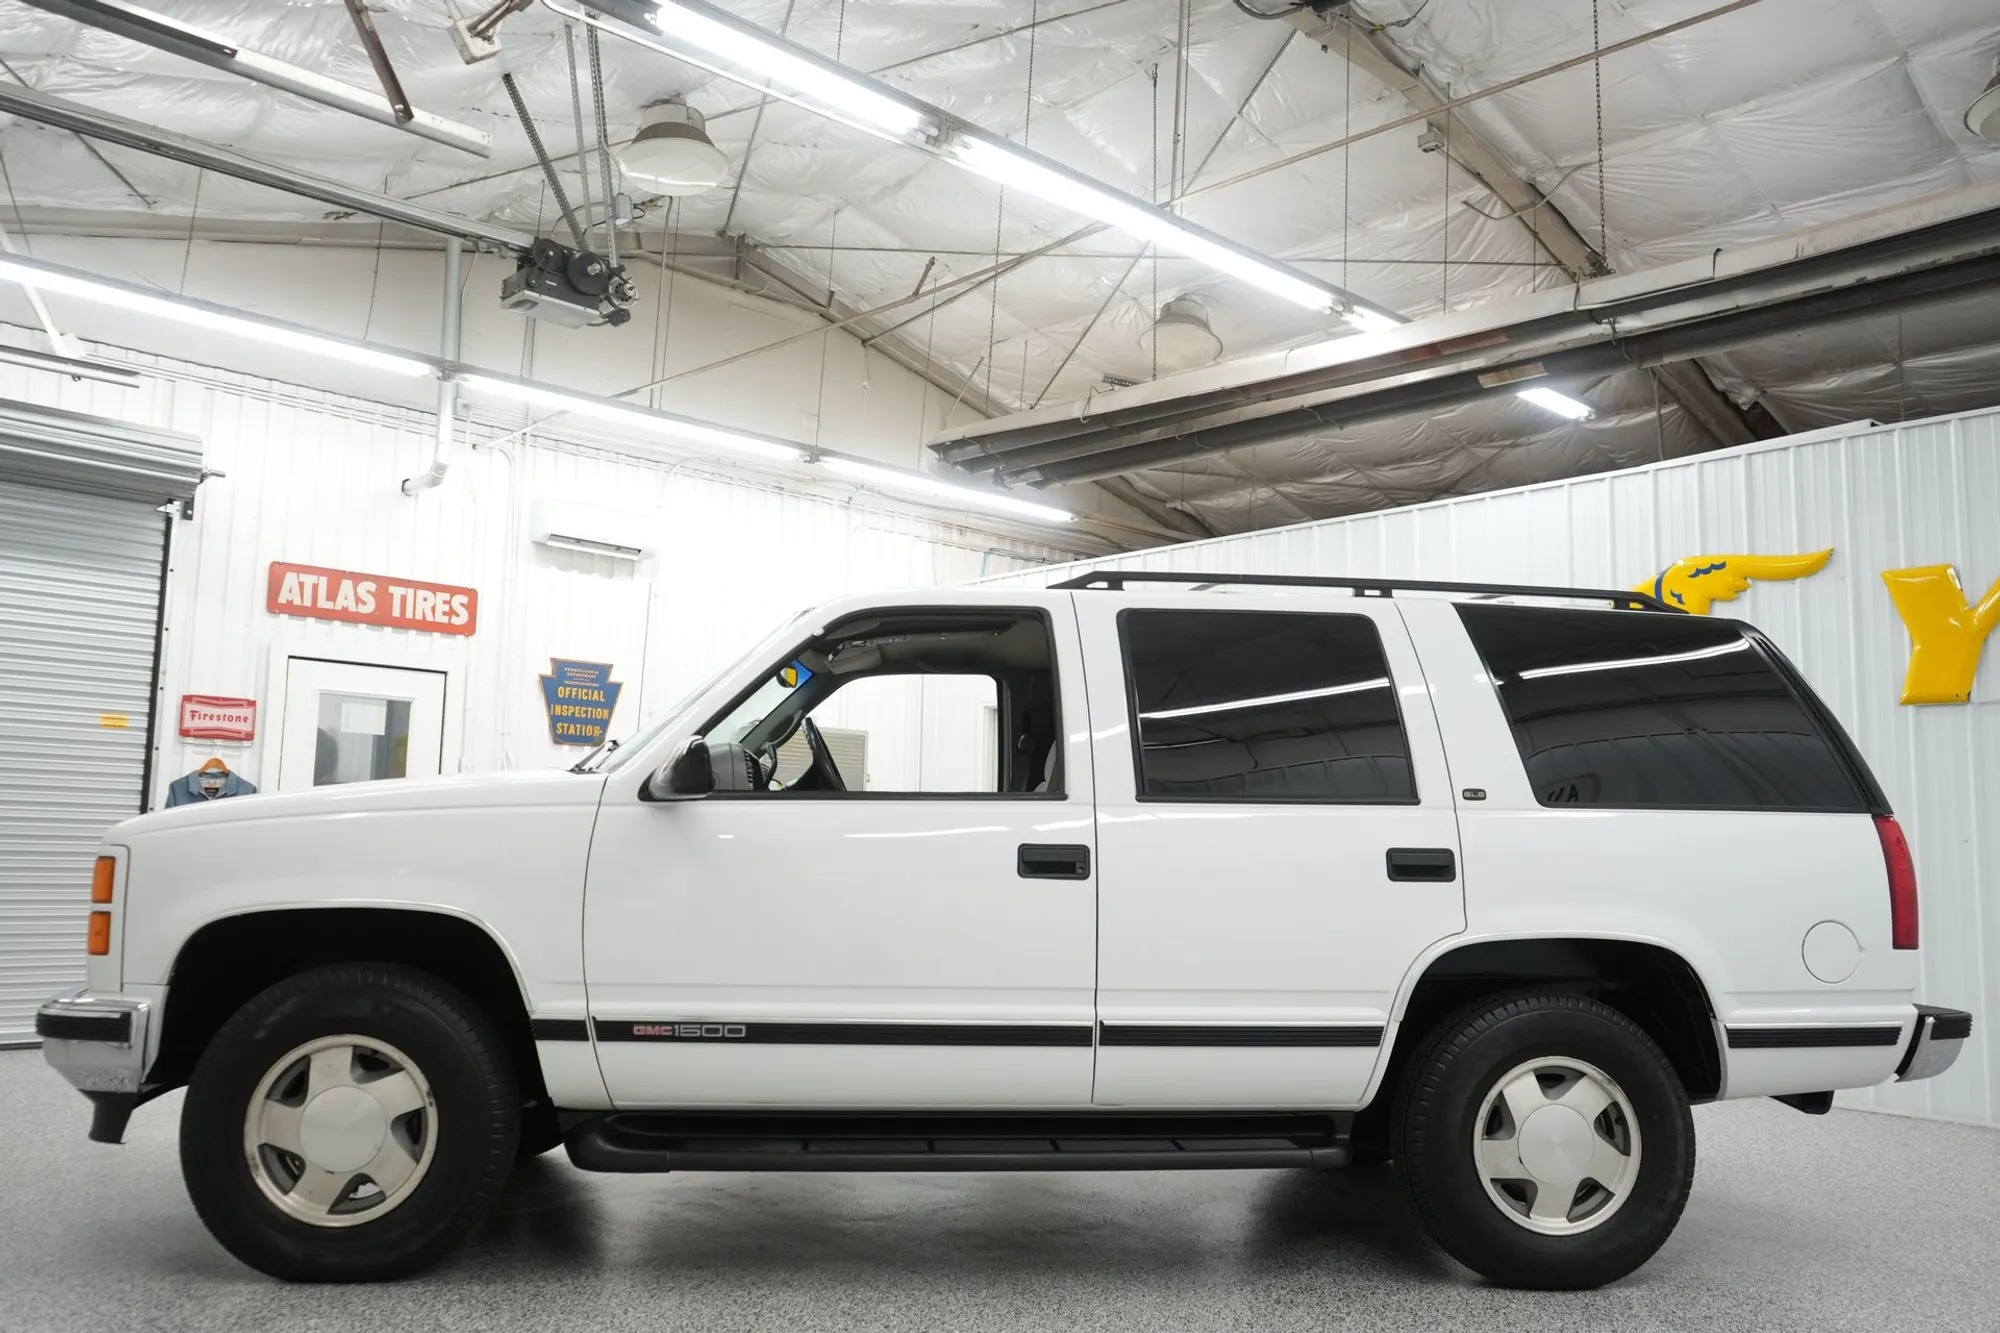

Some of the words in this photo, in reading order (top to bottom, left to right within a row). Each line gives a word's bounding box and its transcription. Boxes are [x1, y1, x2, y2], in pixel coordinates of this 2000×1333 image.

[277, 571, 378, 614] ATLAS
[388, 585, 469, 627] TIRES
[558, 687, 606, 702] OFFICIAL
[189, 709, 249, 724] Firestone
[551, 704, 609, 719] INSPECTION
[557, 722, 602, 737] STATION
[633, 1025, 673, 1036] GMC
[673, 1024, 746, 1038] 1500
